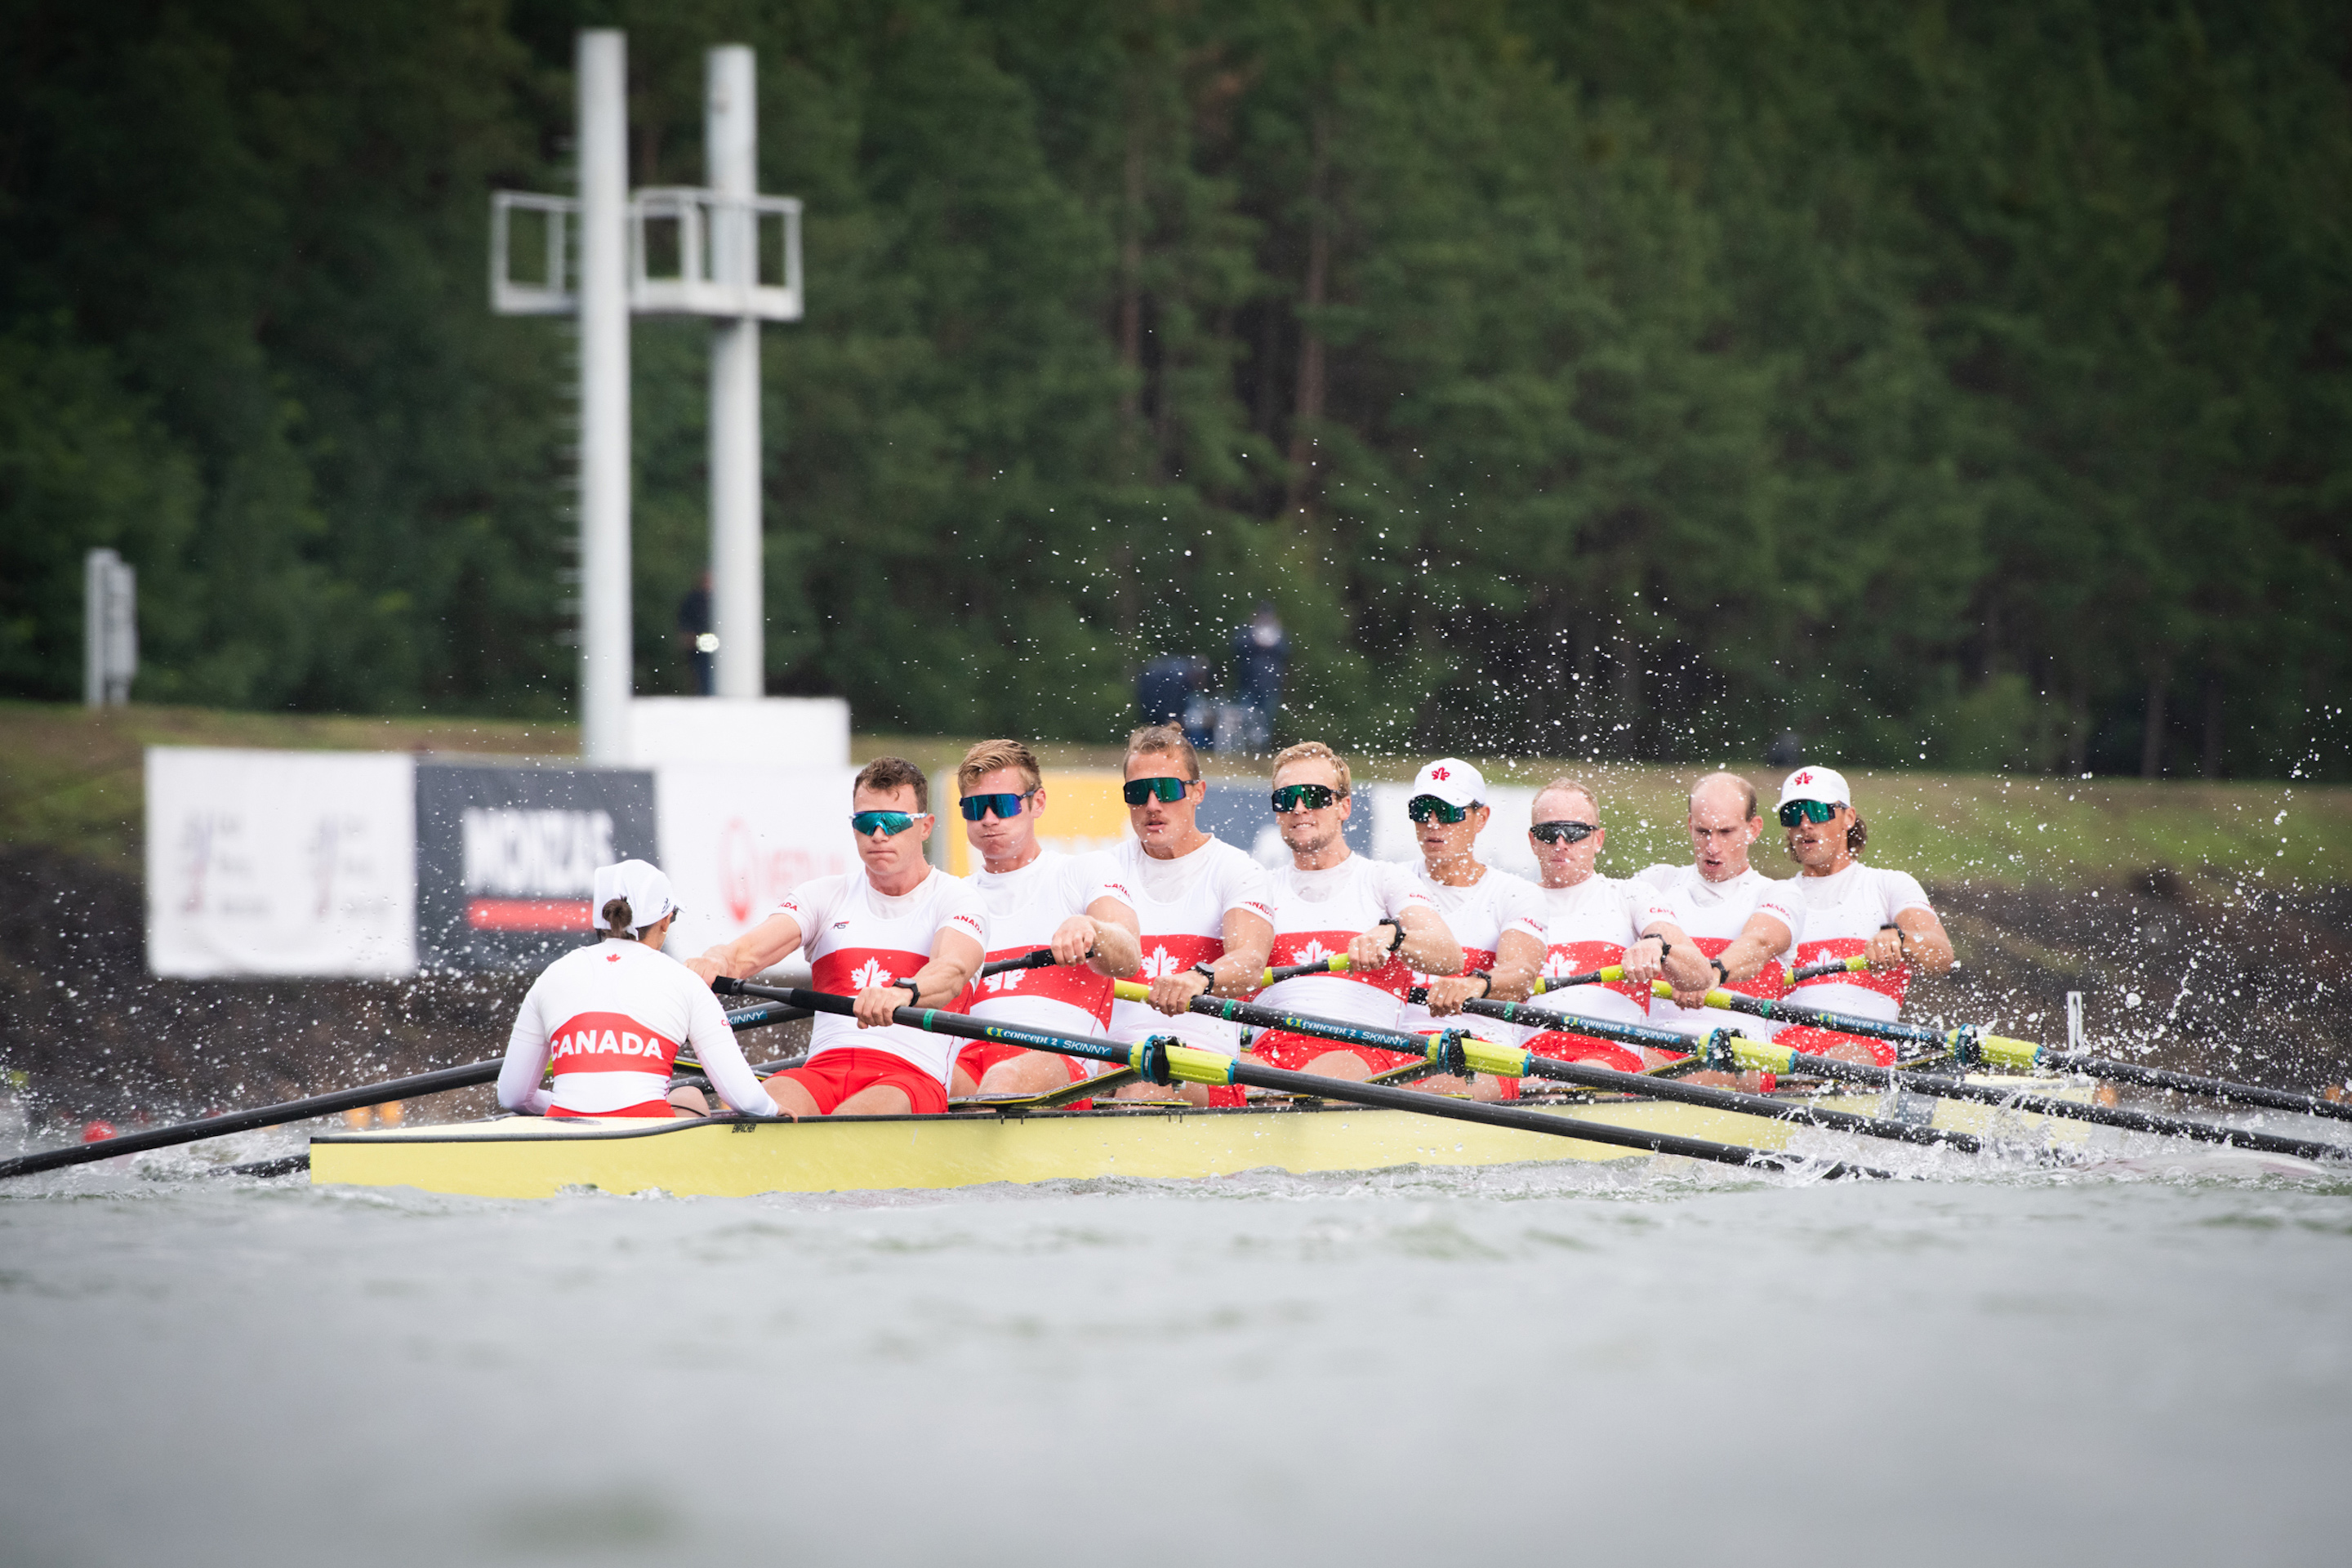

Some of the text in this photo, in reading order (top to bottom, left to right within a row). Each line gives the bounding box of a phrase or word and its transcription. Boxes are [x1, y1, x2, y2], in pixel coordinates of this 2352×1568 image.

[1003, 1030, 1111, 1054] concept 2 SKINNY
[1302, 1021, 1409, 1046] concept 2 SKINNY
[1579, 1018, 1623, 1031] concept
[1634, 1027, 1680, 1042] SKINNY
[550, 1029, 664, 1062] CANADA
